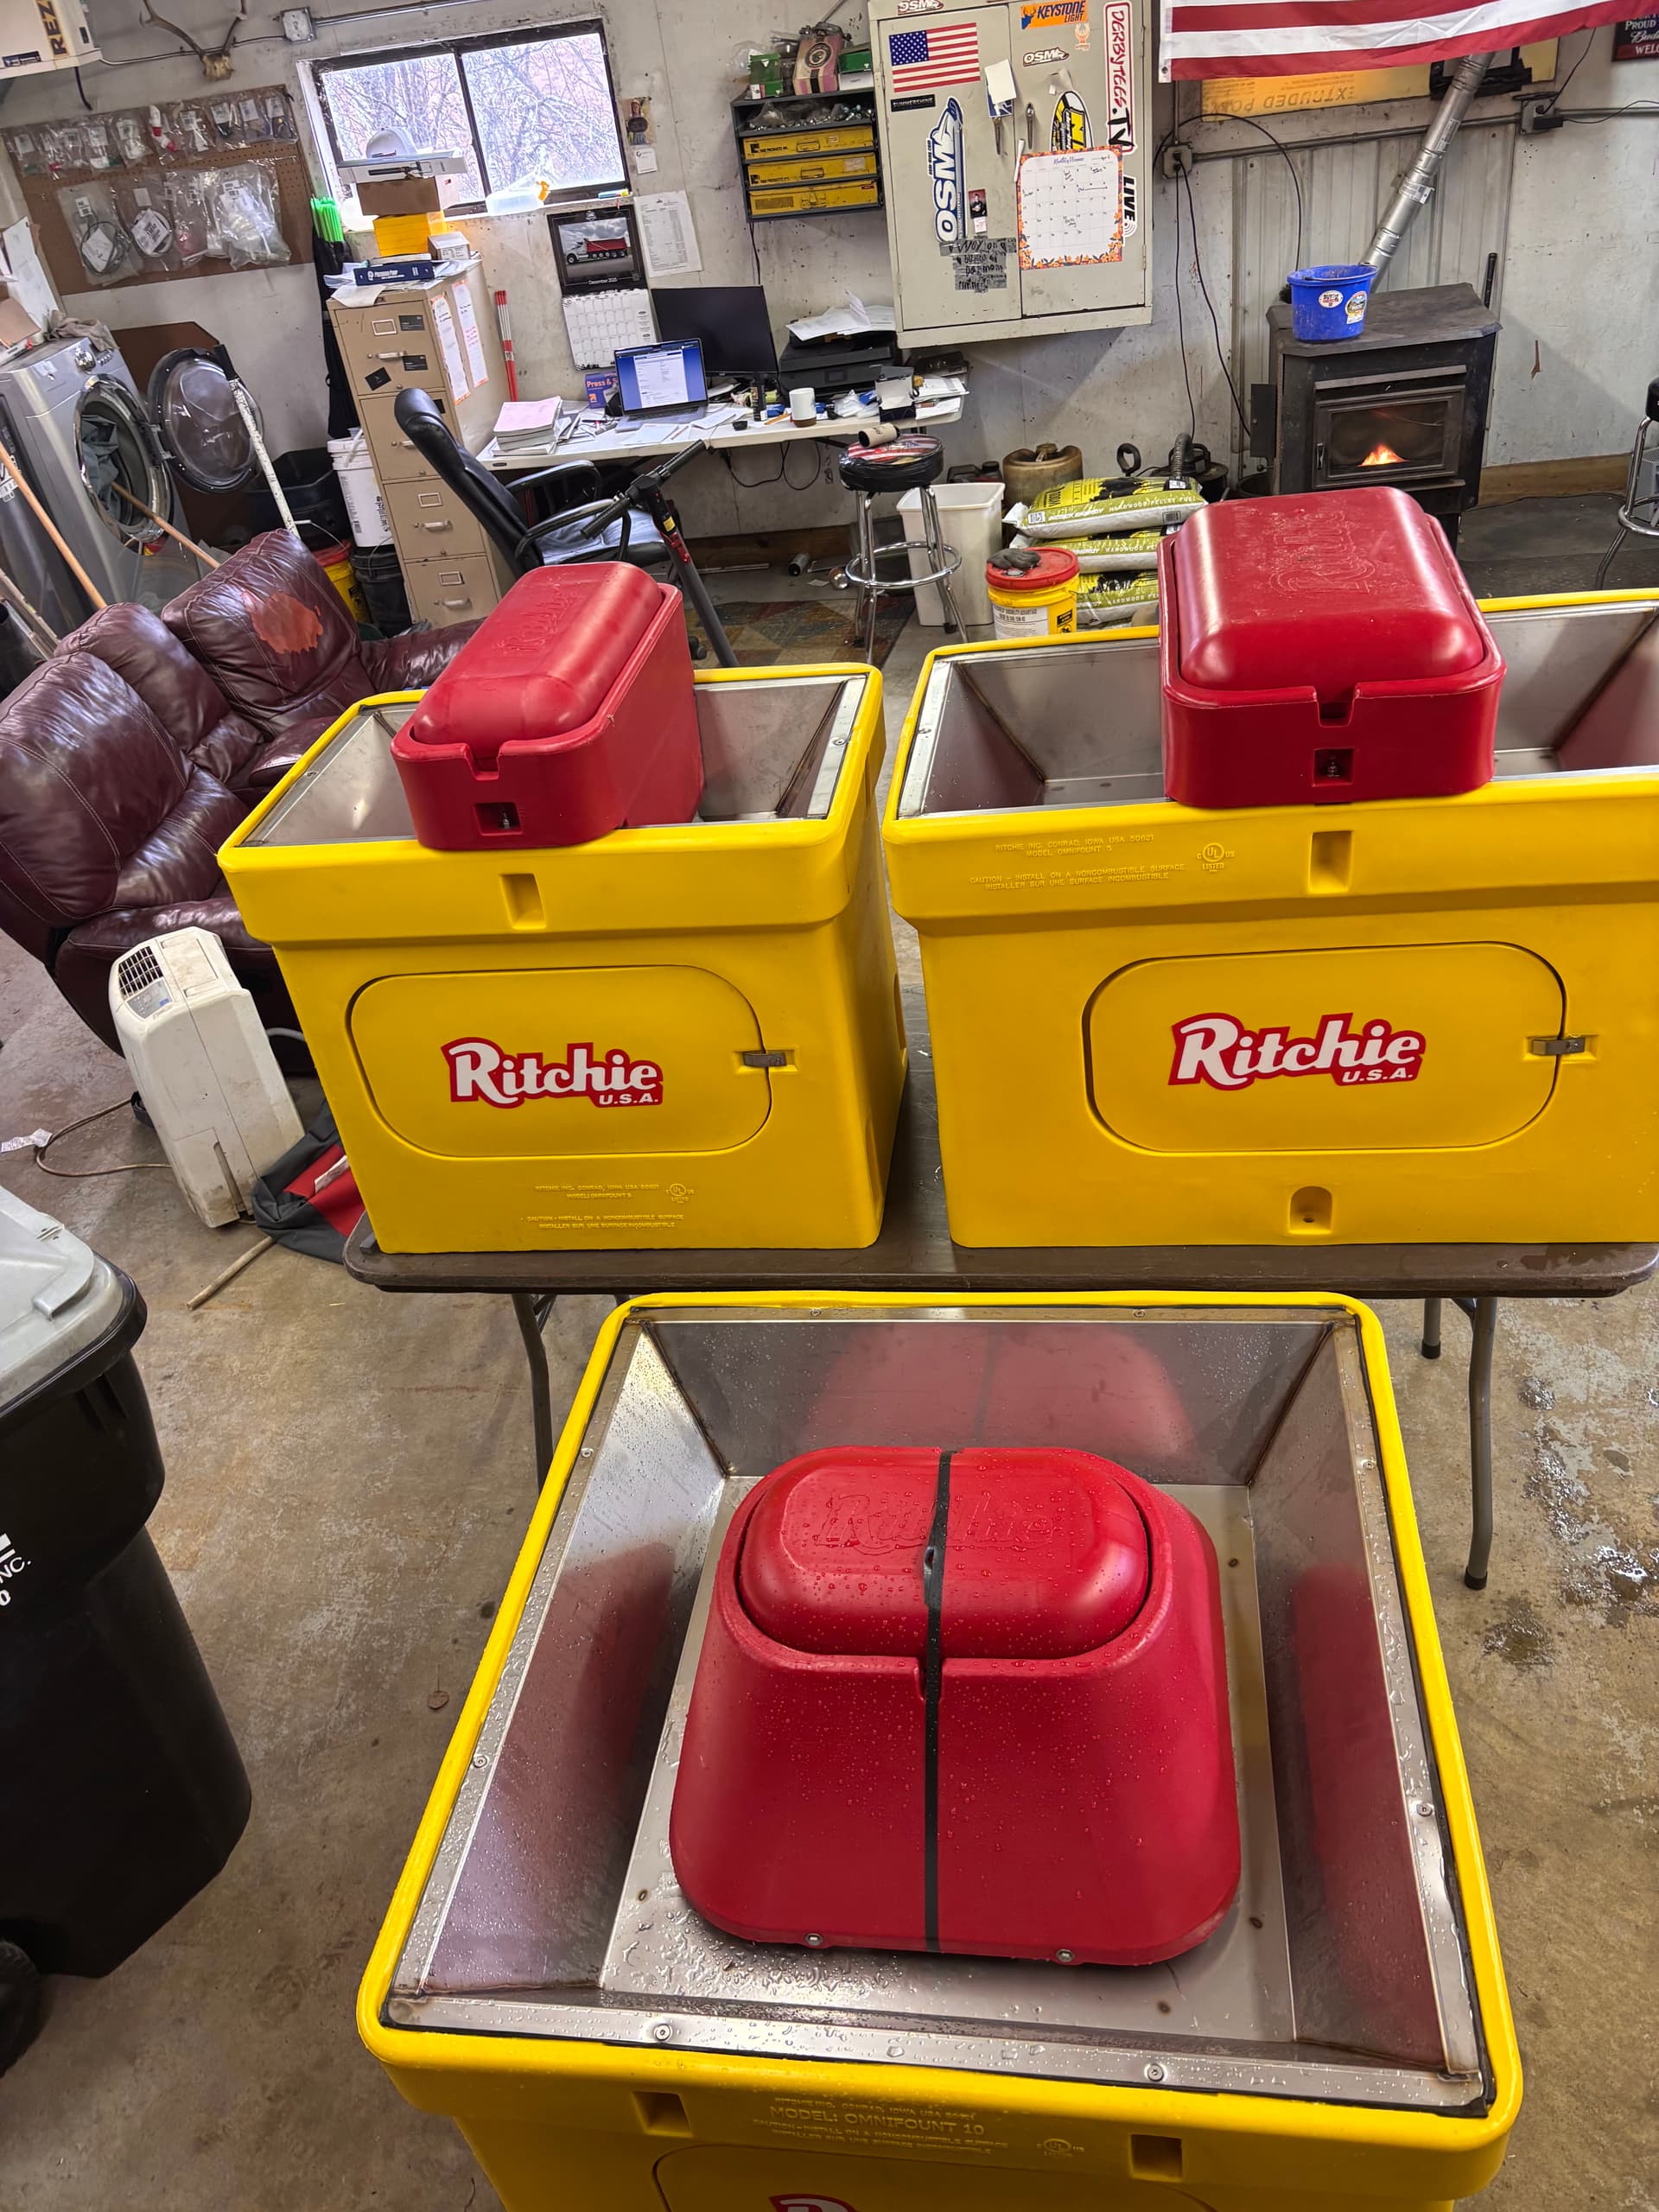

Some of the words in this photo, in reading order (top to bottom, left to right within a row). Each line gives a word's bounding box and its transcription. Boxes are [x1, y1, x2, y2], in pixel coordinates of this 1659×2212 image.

[1037, 1, 1085, 19] KEYSTONE
[1065, 13, 1084, 23] LIGHT
[1624, 20, 1656, 30] PROUD
[1123, 176, 1135, 221] LIVE
[587, 379, 606, 388] Press
[969, 875, 1002, 884] CAUTION
[1177, 1018, 1421, 1086] Ritchie
[448, 1042, 658, 1104] Ritchie
[1342, 1067, 1413, 1083] U.S.A.
[599, 1092, 658, 1105] U.S.A.
[769, 2106, 838, 2123] MODEL:
[844, 2113, 957, 2133] OMNIFOUNT
[963, 2123, 985, 2135] 10
